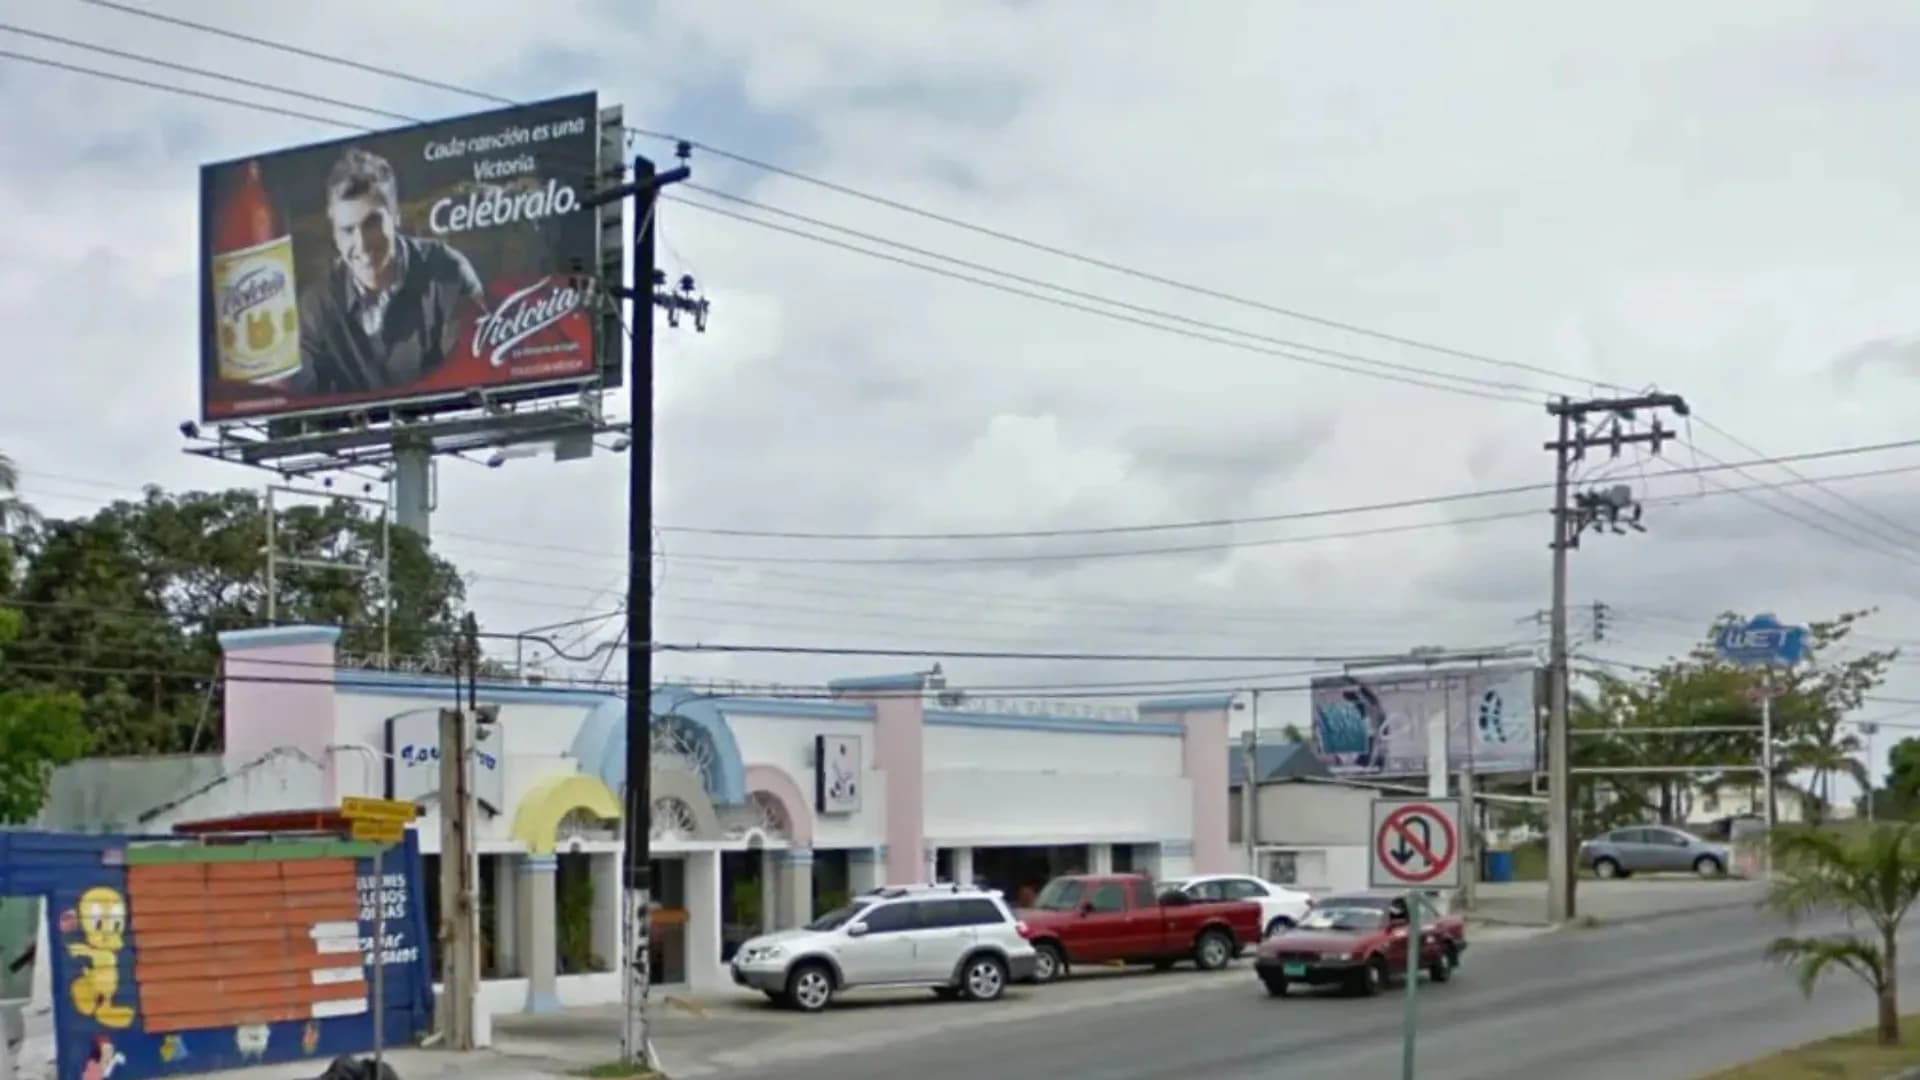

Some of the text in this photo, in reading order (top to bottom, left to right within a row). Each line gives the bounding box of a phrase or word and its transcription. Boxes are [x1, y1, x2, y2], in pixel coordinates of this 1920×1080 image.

[424, 136, 466, 161] Cada
[532, 124, 550, 142] es
[552, 117, 586, 138] una
[429, 178, 582, 233] Celébralo.
[471, 275, 580, 368] Victoria
